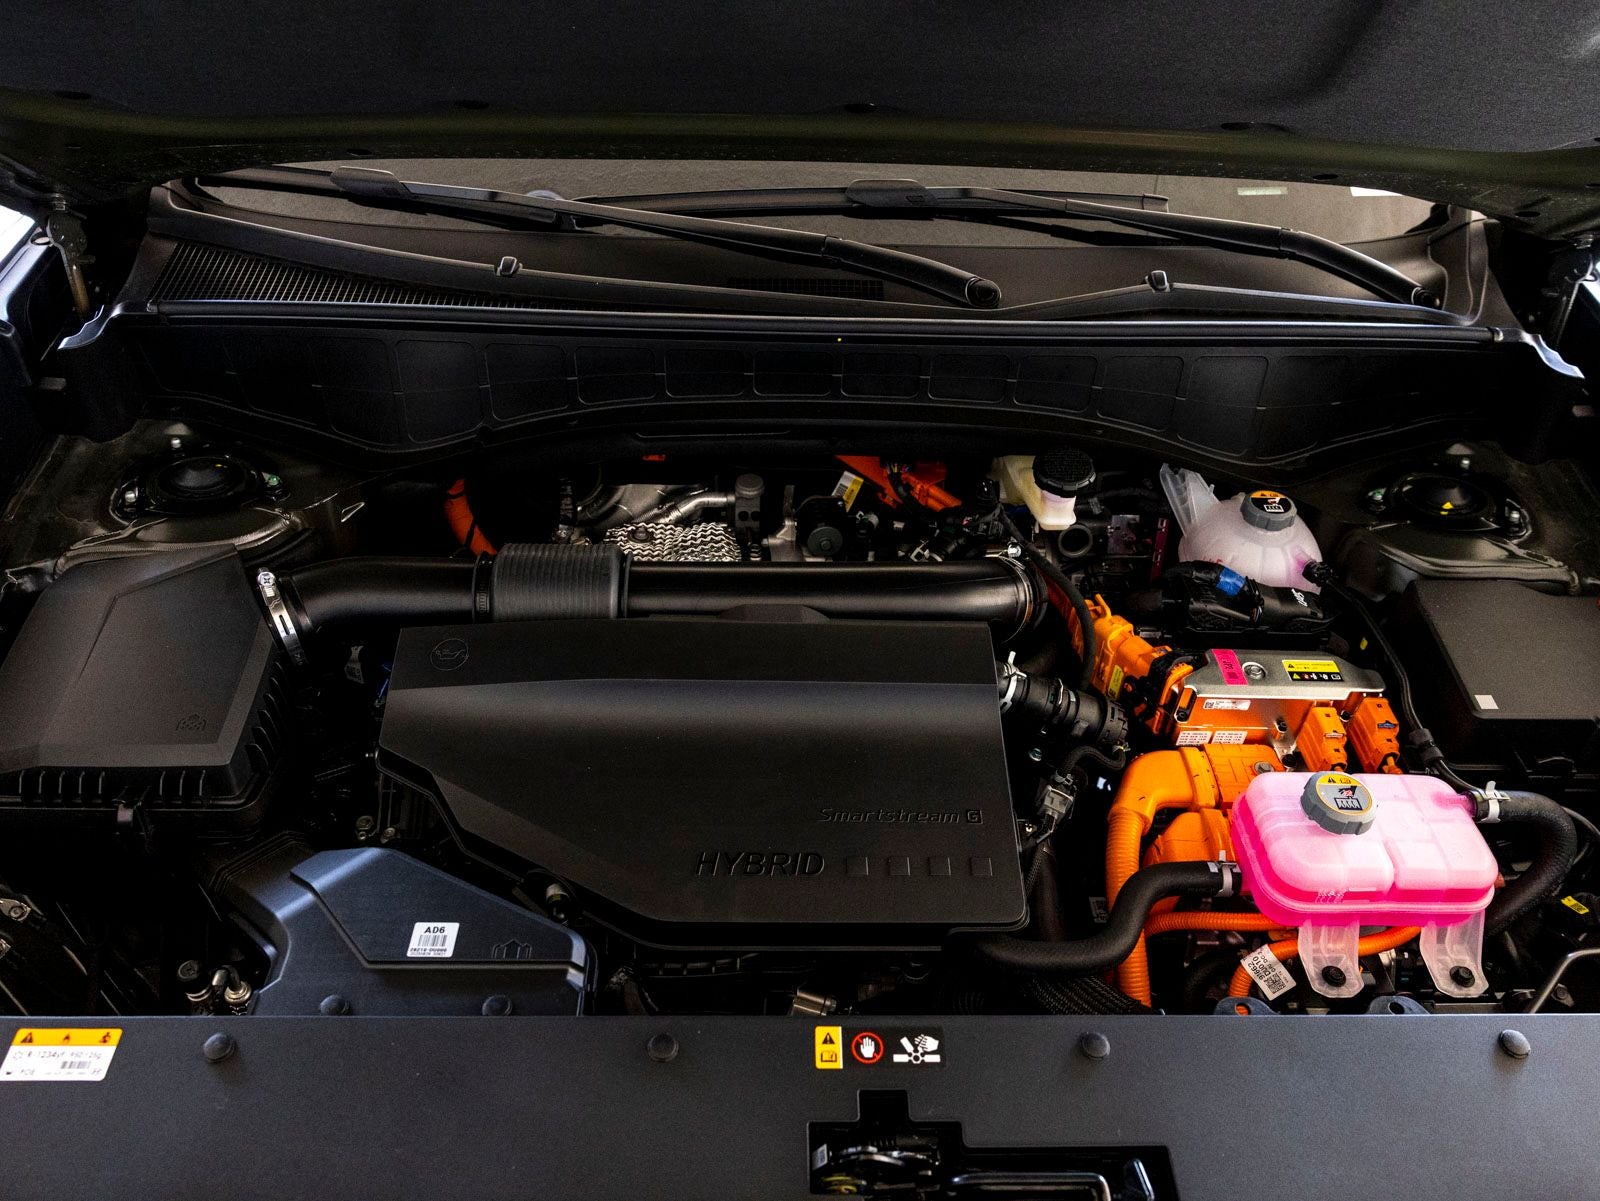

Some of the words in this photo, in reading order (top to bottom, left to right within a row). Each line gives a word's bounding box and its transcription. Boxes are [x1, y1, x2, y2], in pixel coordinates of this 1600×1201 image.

[819, 808, 961, 825] Smartstream
[965, 809, 984, 825] G
[696, 852, 826, 877] HYBRID
[424, 926, 446, 934] AD6
